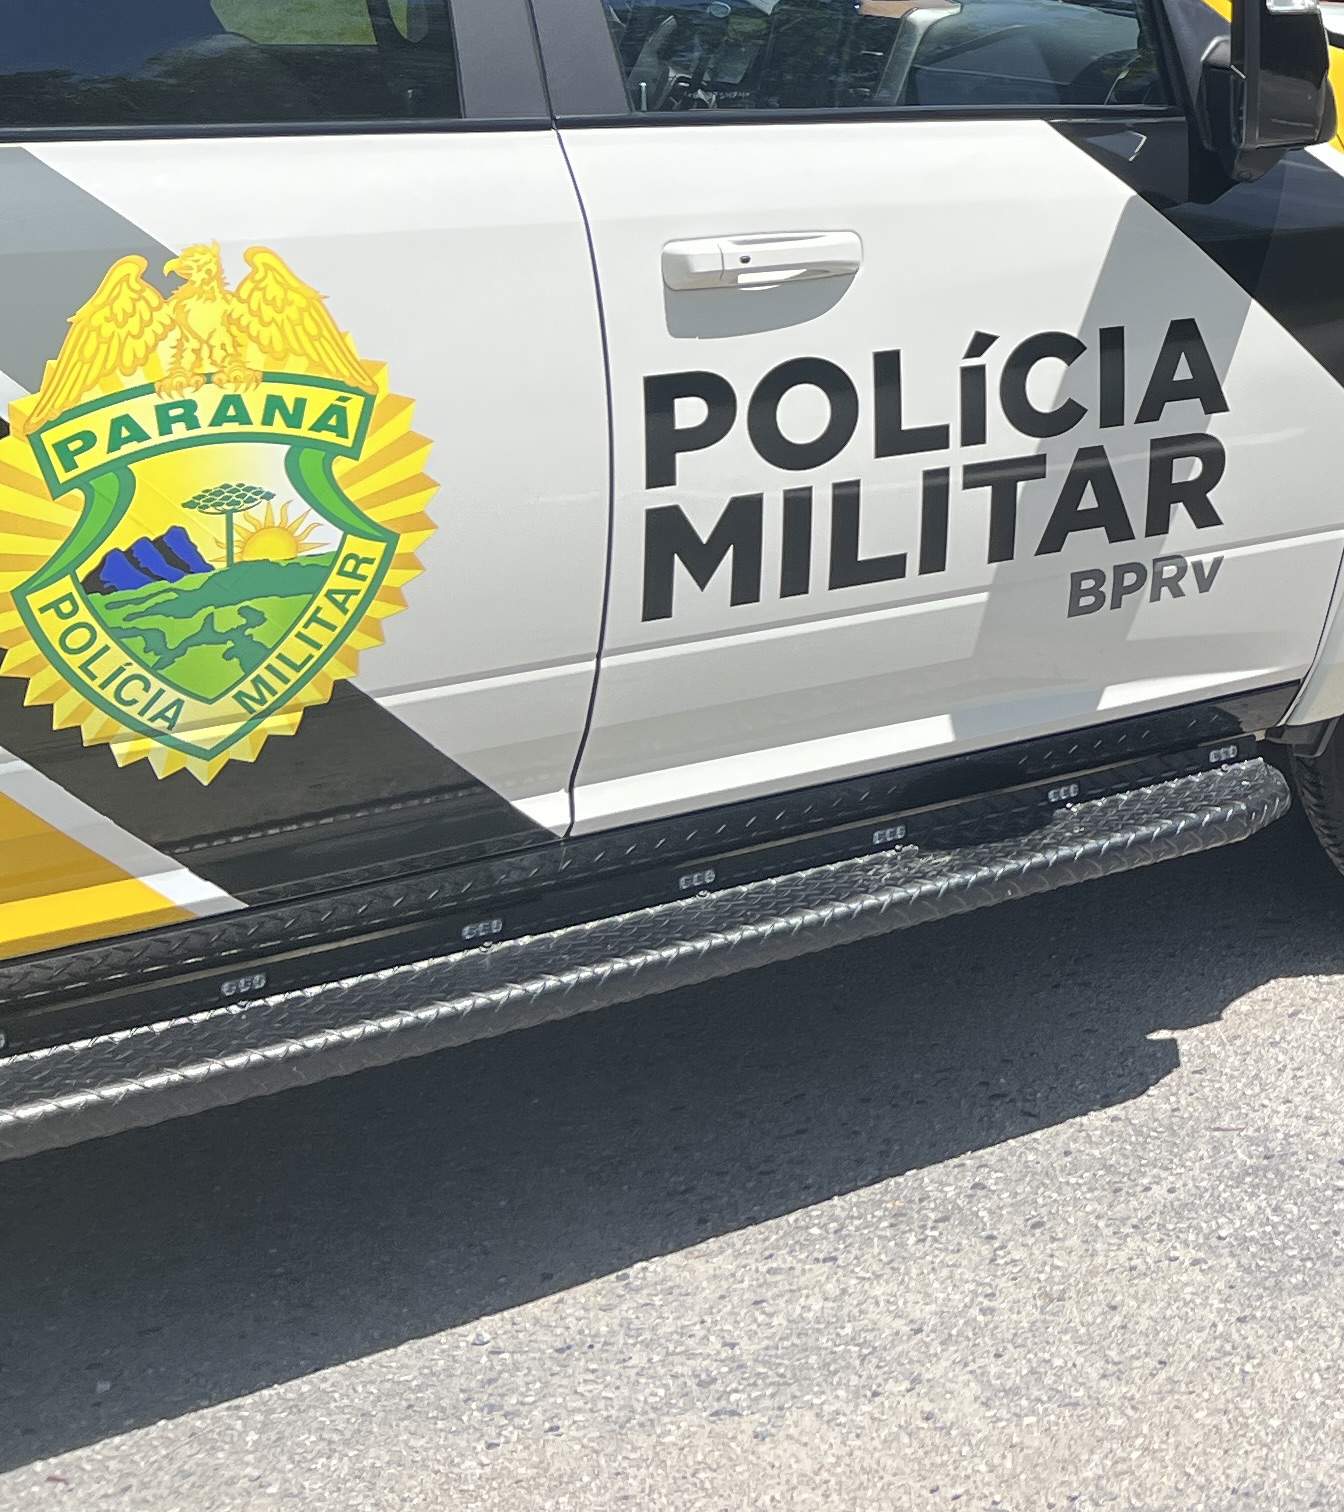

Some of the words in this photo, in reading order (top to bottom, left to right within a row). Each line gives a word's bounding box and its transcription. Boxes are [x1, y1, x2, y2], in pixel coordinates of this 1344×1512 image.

[51, 393, 352, 473] PARANÁ
[643, 317, 1231, 490] POLÍCIA
[642, 432, 1227, 623] MILITAR
[38, 591, 184, 731] POLÍCIA
[234, 549, 377, 715] MILITAR
